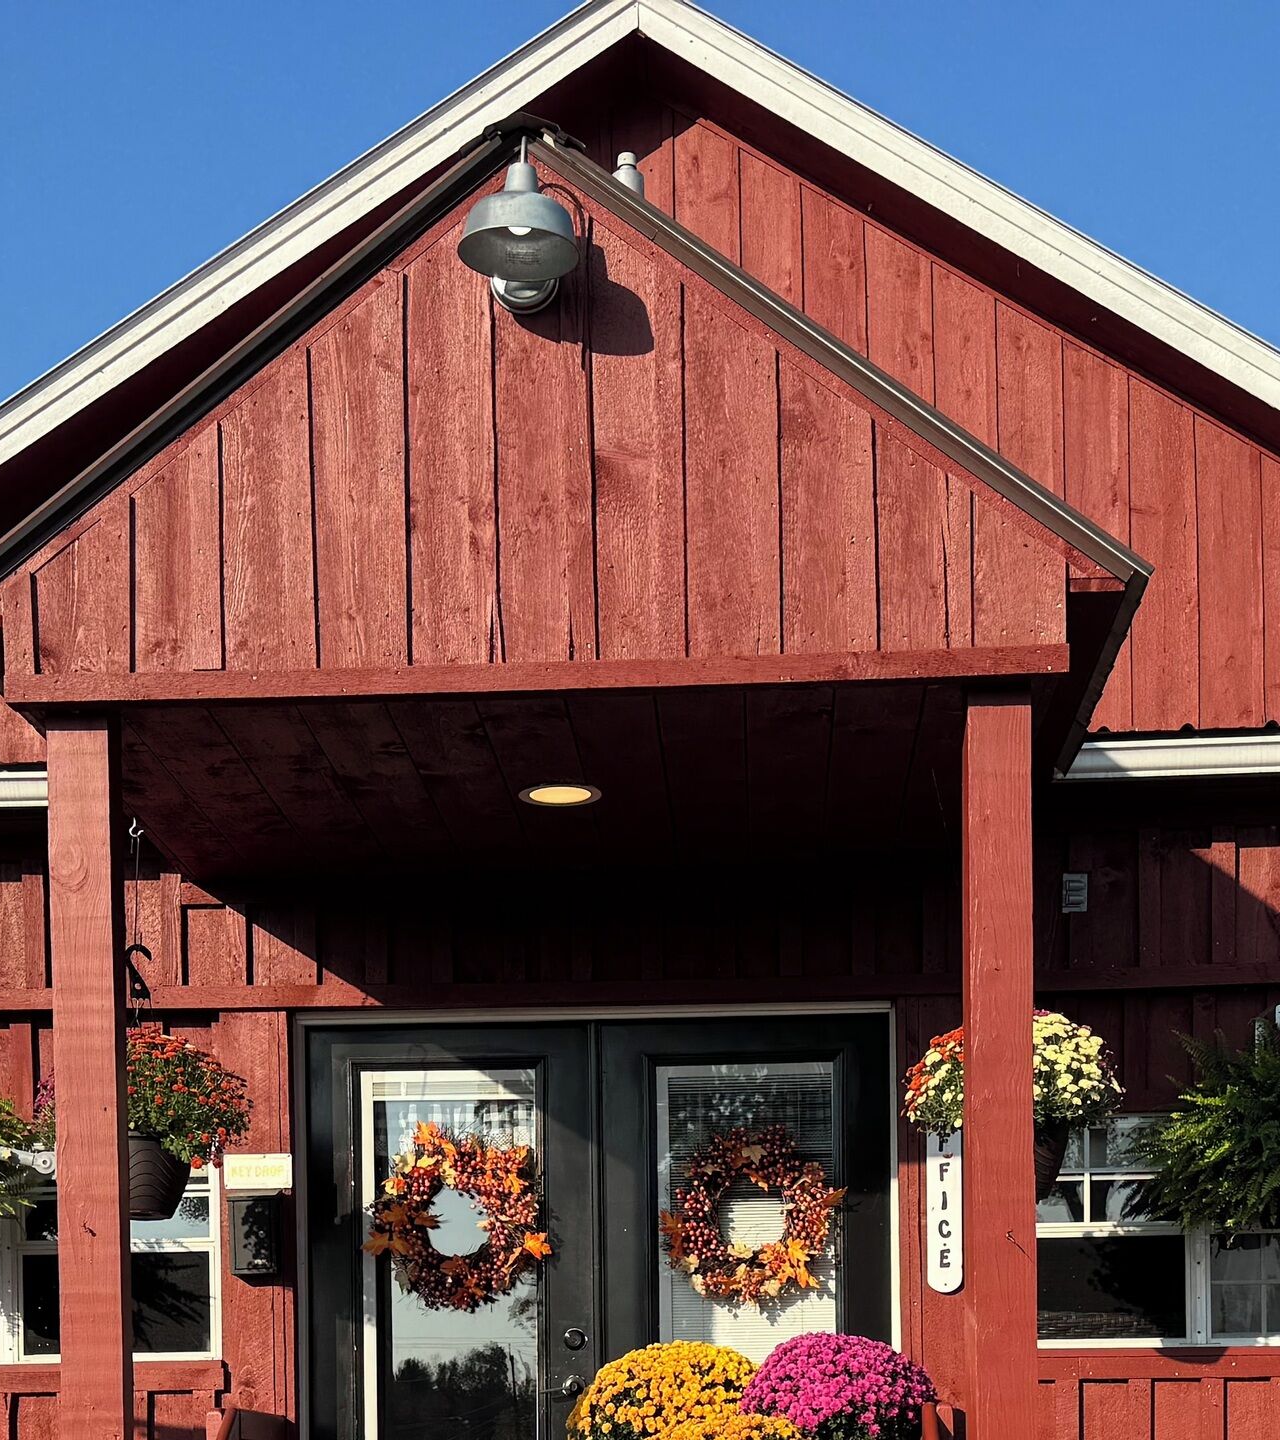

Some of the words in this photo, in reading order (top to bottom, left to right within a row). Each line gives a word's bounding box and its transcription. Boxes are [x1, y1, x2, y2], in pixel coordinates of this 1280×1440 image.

[230, 1165, 252, 1177] KEY
[254, 1165, 285, 1177] DROP
[937, 1130, 952, 1269] FFICE
